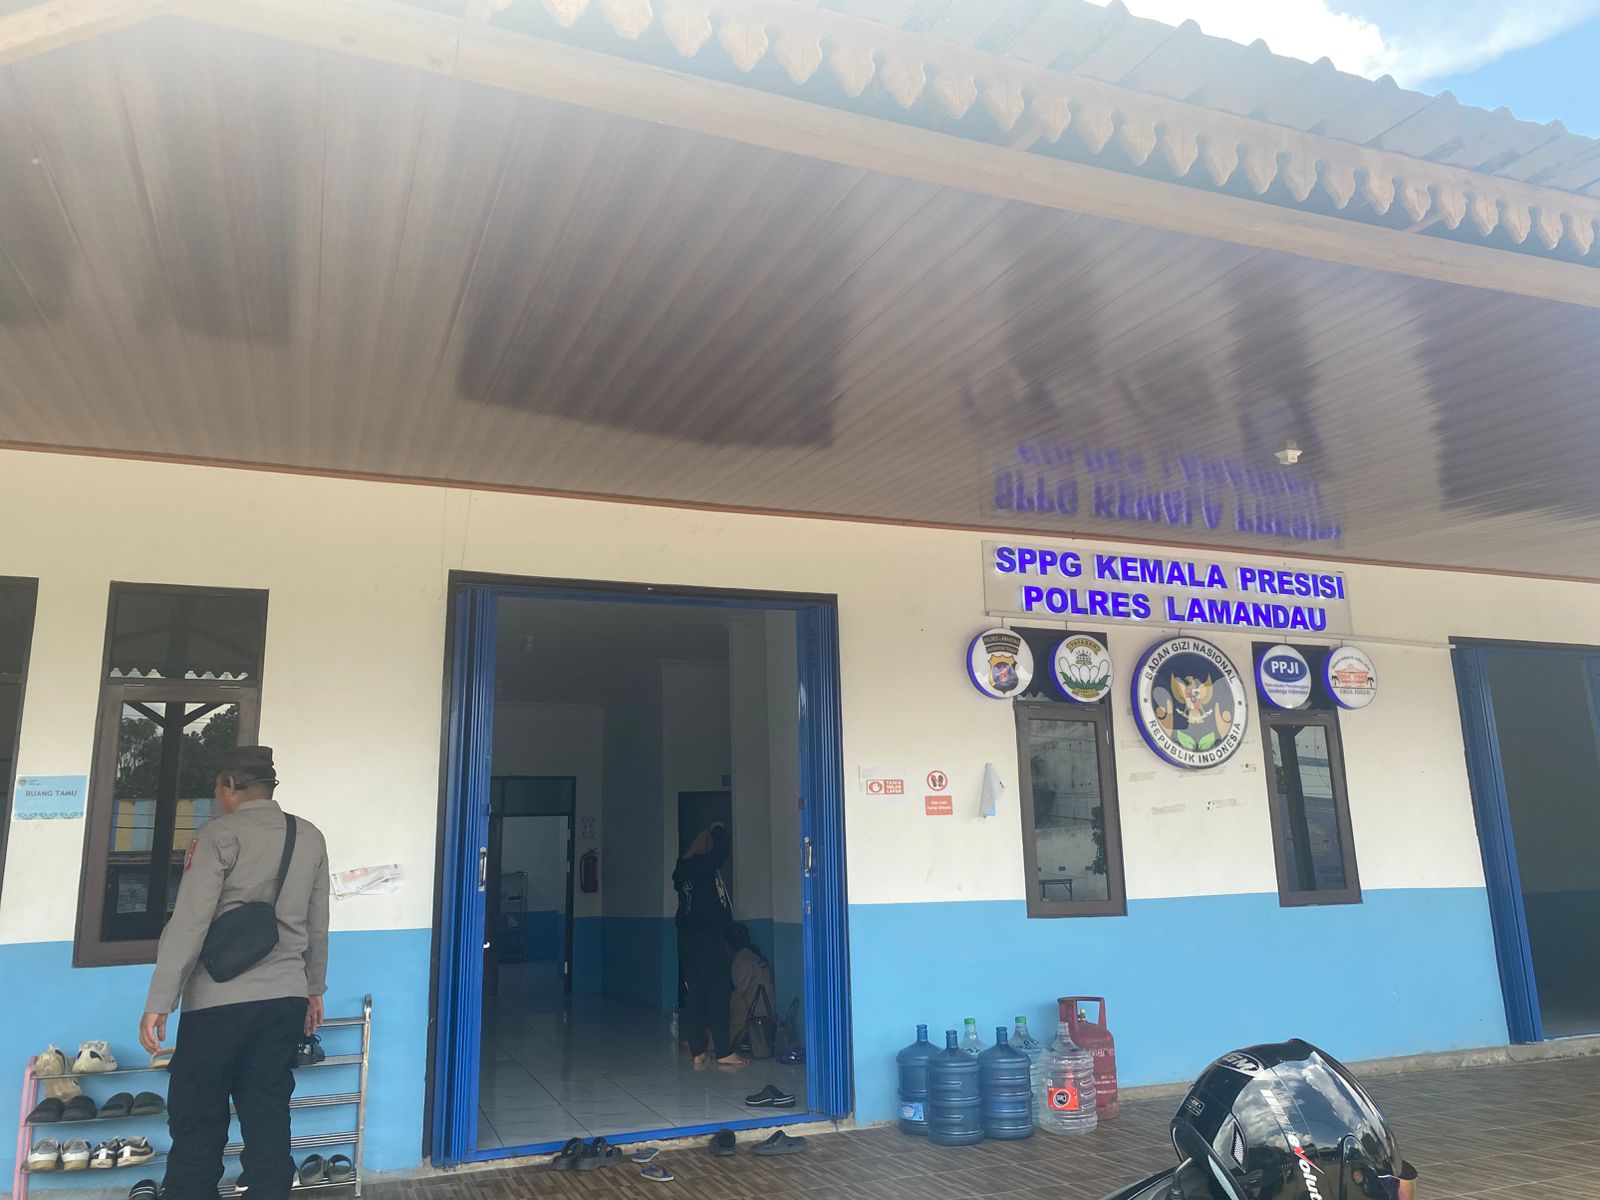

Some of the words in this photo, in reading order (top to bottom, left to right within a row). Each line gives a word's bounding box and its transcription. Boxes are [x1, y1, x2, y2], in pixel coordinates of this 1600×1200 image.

[995, 546, 1082, 578] SPPG
[1095, 554, 1227, 589] KEMALA
[1239, 567, 1345, 600] PRESISI
[1022, 585, 1151, 619] POLRES
[1166, 596, 1327, 631] LAMANDAU
[1145, 646, 1170, 680] BADAN
[1171, 641, 1190, 652] GIZI
[1193, 641, 1236, 683] NASIONAL
[1271, 661, 1299, 675] PPJI
[1149, 719, 1195, 763] REPUBLIK
[1198, 722, 1241, 763] INDONESIA
